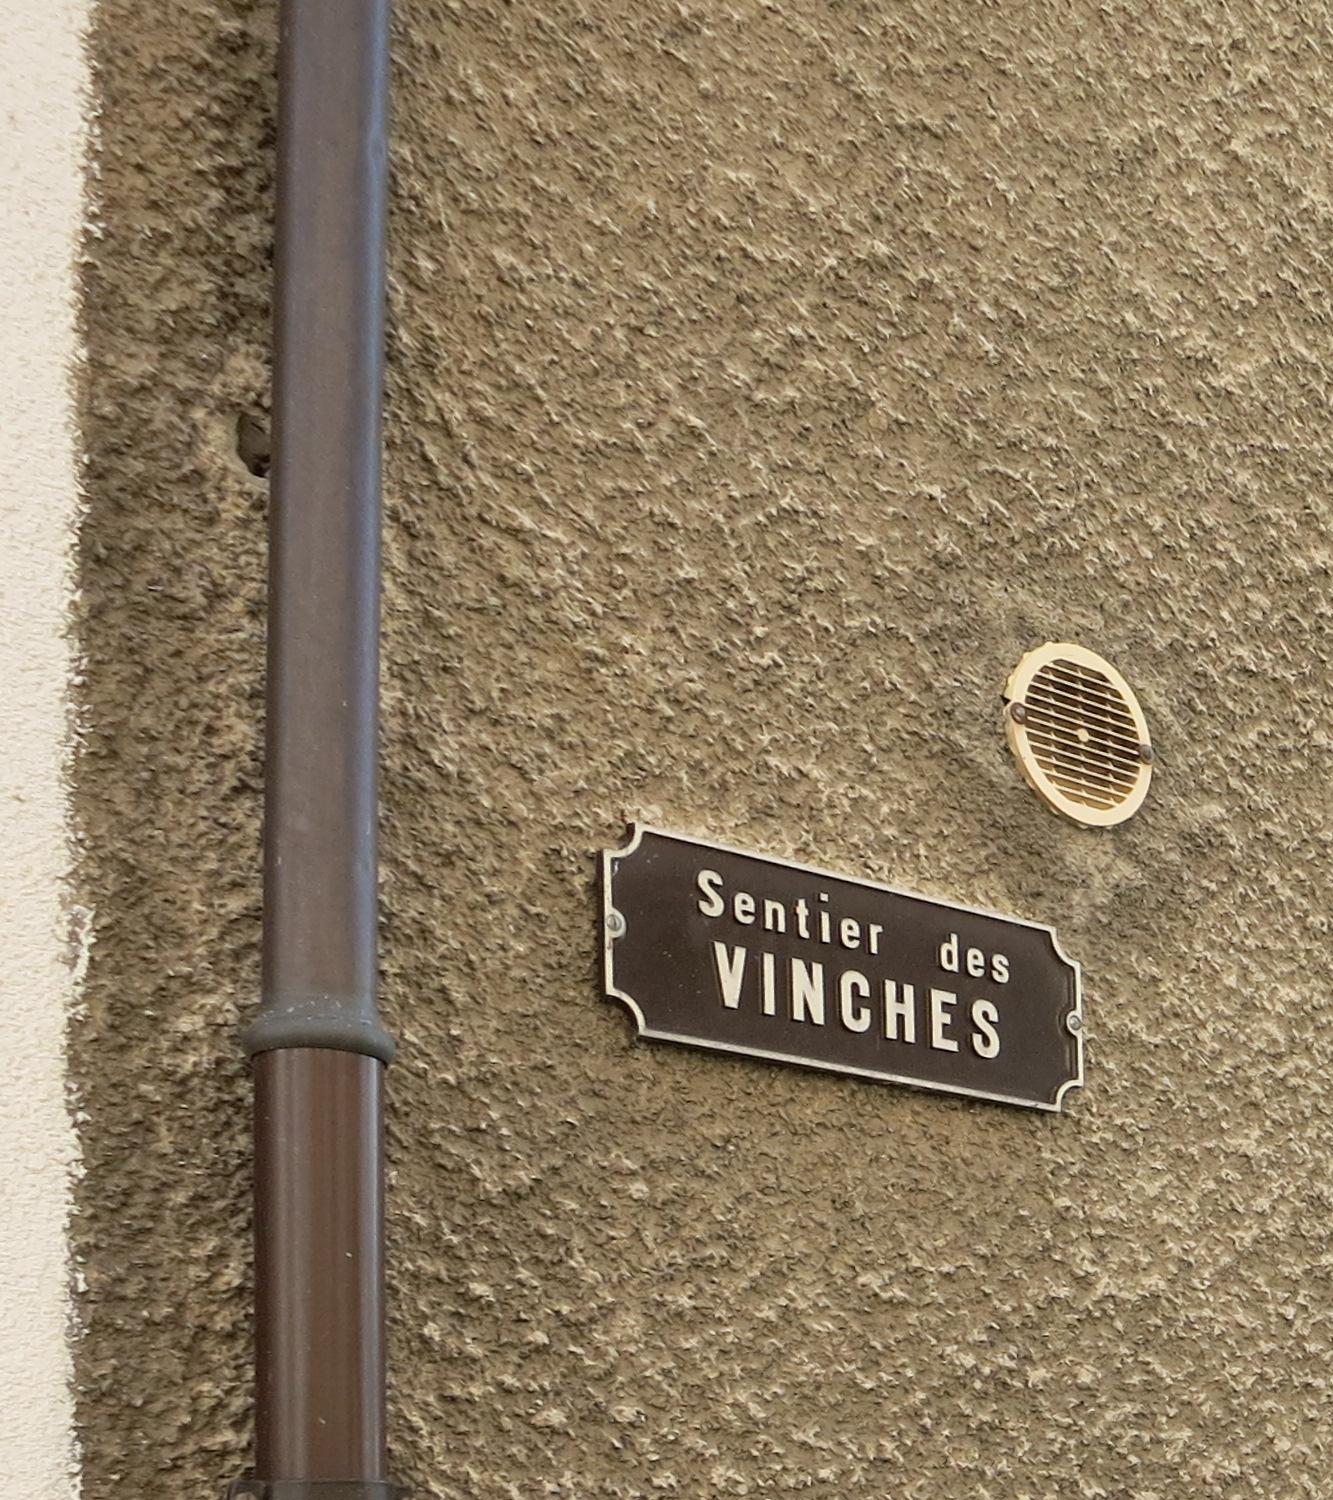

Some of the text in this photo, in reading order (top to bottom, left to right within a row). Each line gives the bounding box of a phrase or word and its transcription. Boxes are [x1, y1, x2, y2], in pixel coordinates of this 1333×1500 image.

[697, 869, 1010, 984] Sentier des
[713, 941, 1001, 1060] VINCHES
